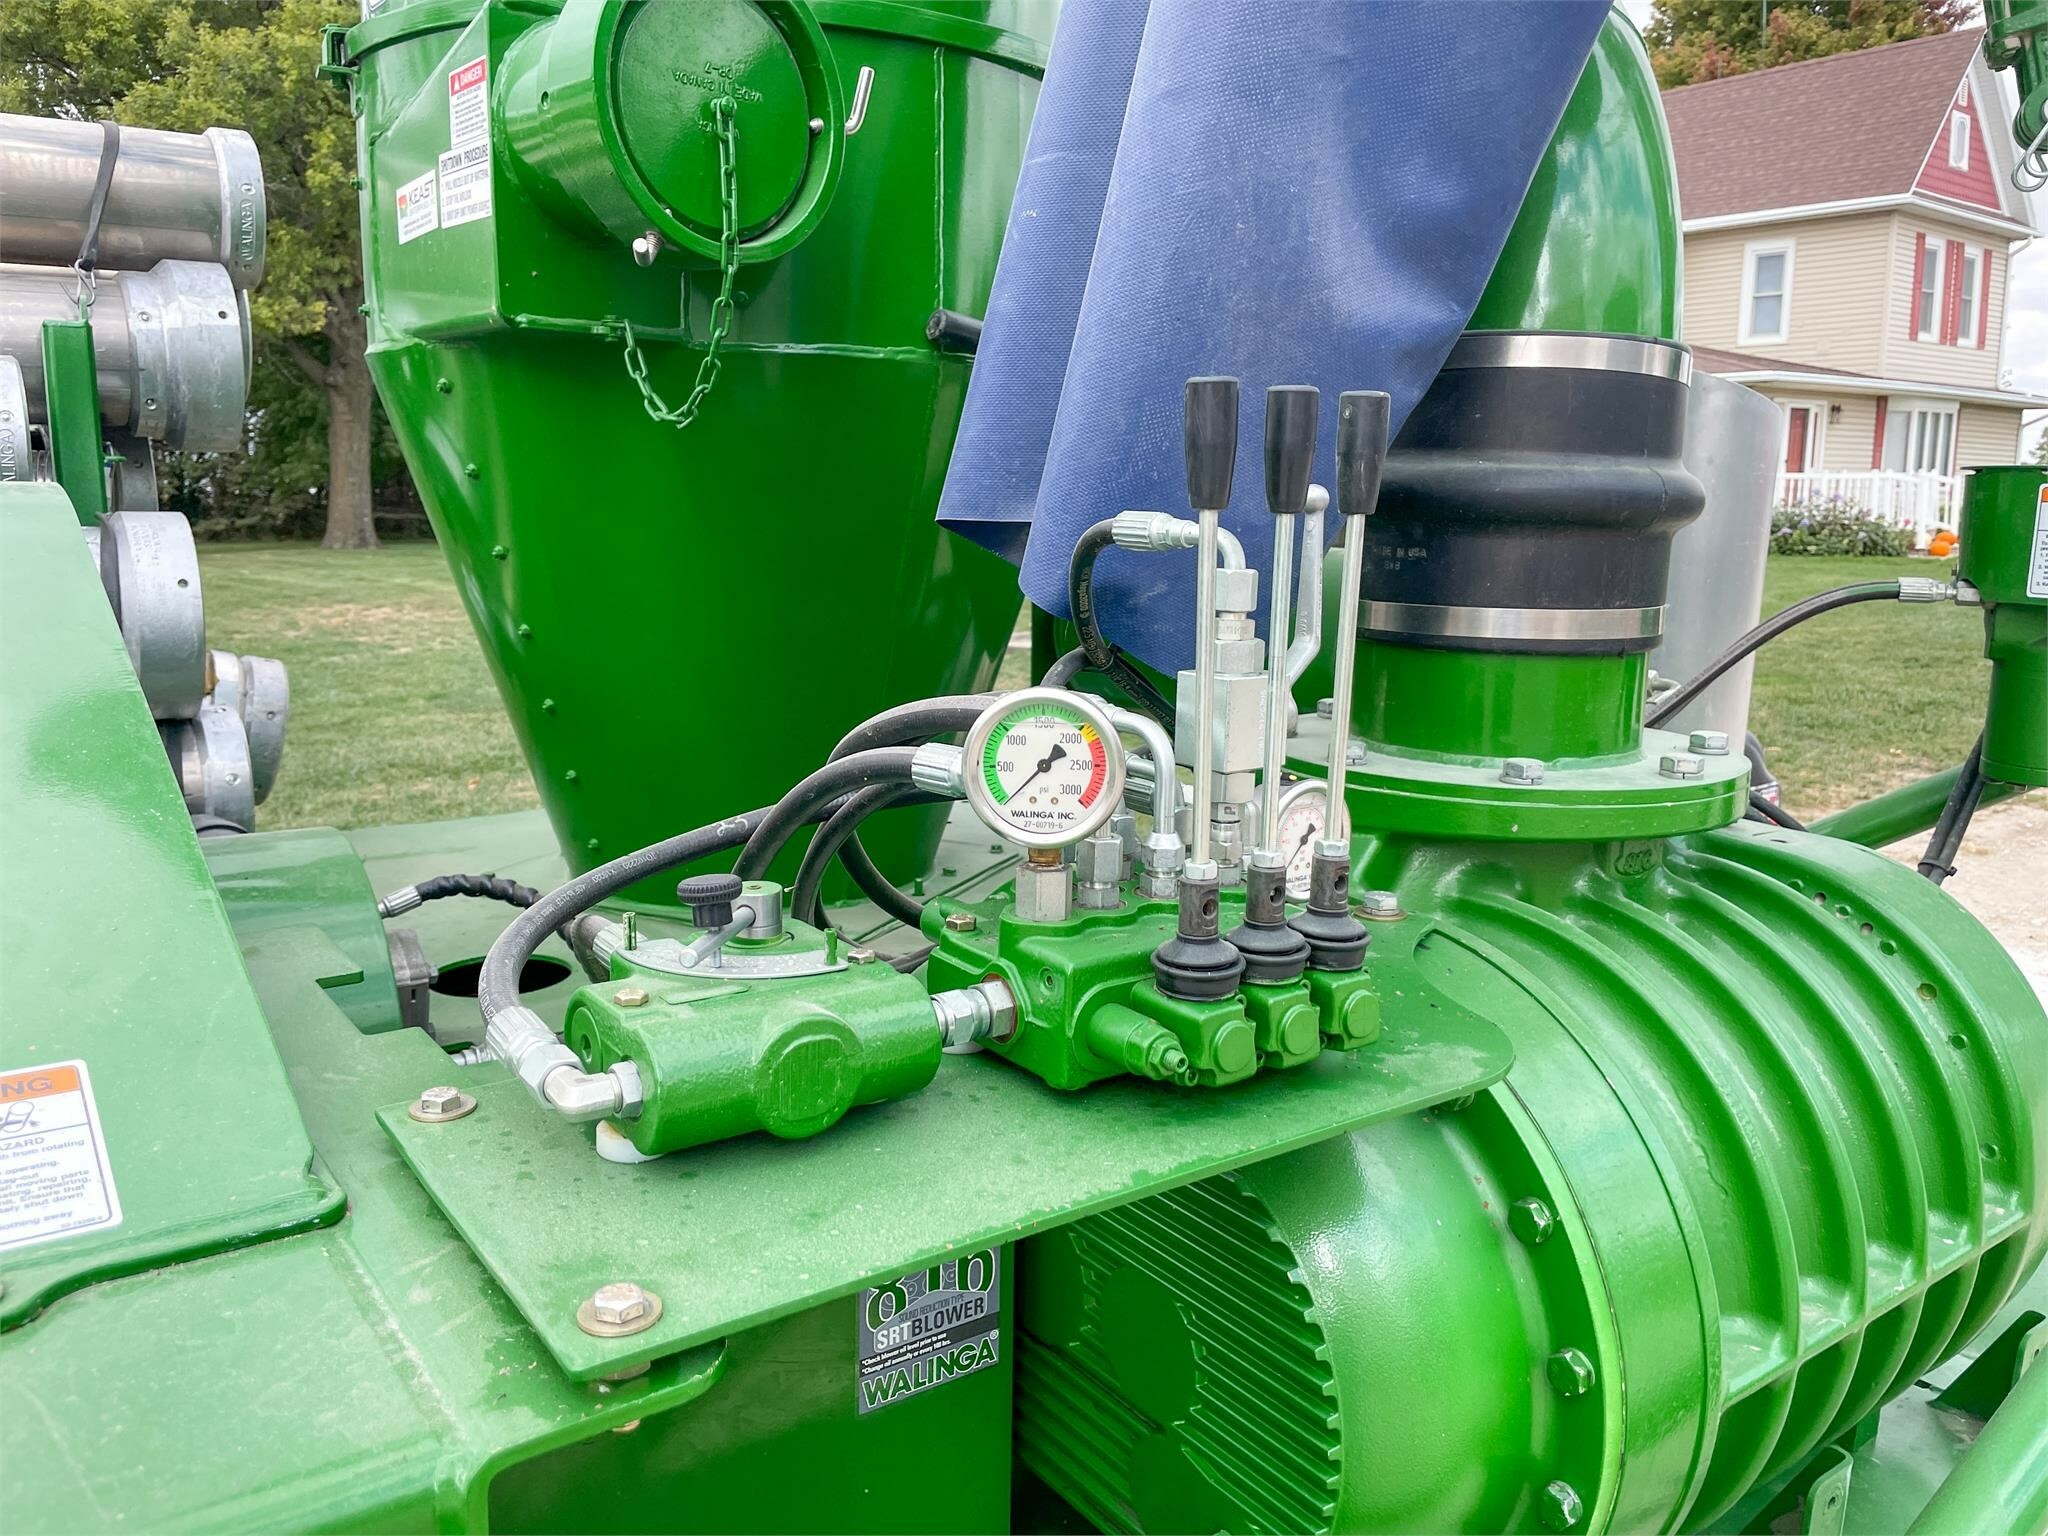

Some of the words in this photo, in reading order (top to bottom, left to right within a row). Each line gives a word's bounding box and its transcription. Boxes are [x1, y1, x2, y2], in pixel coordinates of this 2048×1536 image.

[460, 66, 483, 87] DANGER
[1007, 734, 1027, 746] 1000
[1059, 733, 1082, 744] 2000
[997, 762, 1014, 772] 500
[1070, 760, 1093, 771] 2500
[1039, 786, 1049, 795] psi
[1060, 784, 1082, 795] 3000
[1057, 812, 1077, 820] INC.
[41, 1139, 85, 1153] rotating
[15, 1176, 57, 1188] moving
[61, 1169, 90, 1181] parts
[63, 1184, 85, 1193] that
[52, 1192, 84, 1203] down
